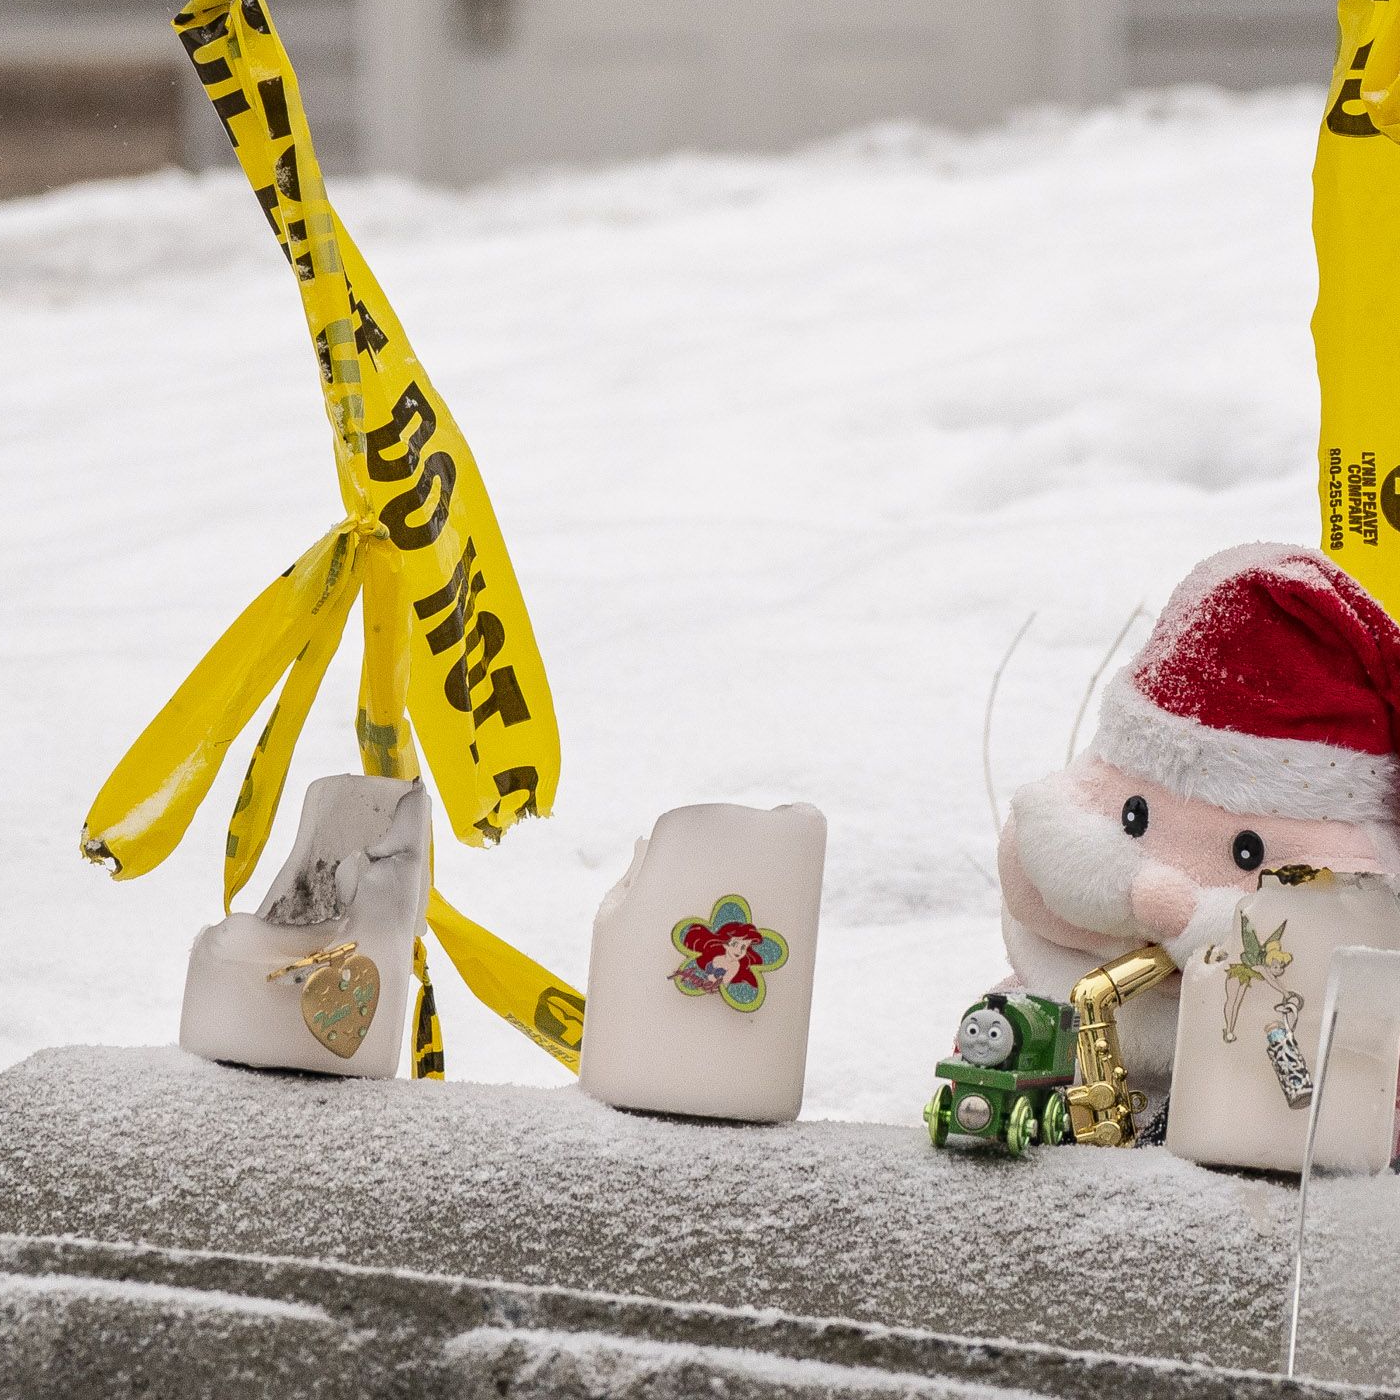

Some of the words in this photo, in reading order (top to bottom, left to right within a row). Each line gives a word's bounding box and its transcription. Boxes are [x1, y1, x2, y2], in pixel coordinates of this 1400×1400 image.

[366, 380, 457, 551] DO
[1329, 448, 1344, 550] 800-255-6499
[1348, 464, 1362, 535] COMPANY
[1362, 451, 1376, 487] LYNN
[1362, 491, 1378, 546] PEAVEY
